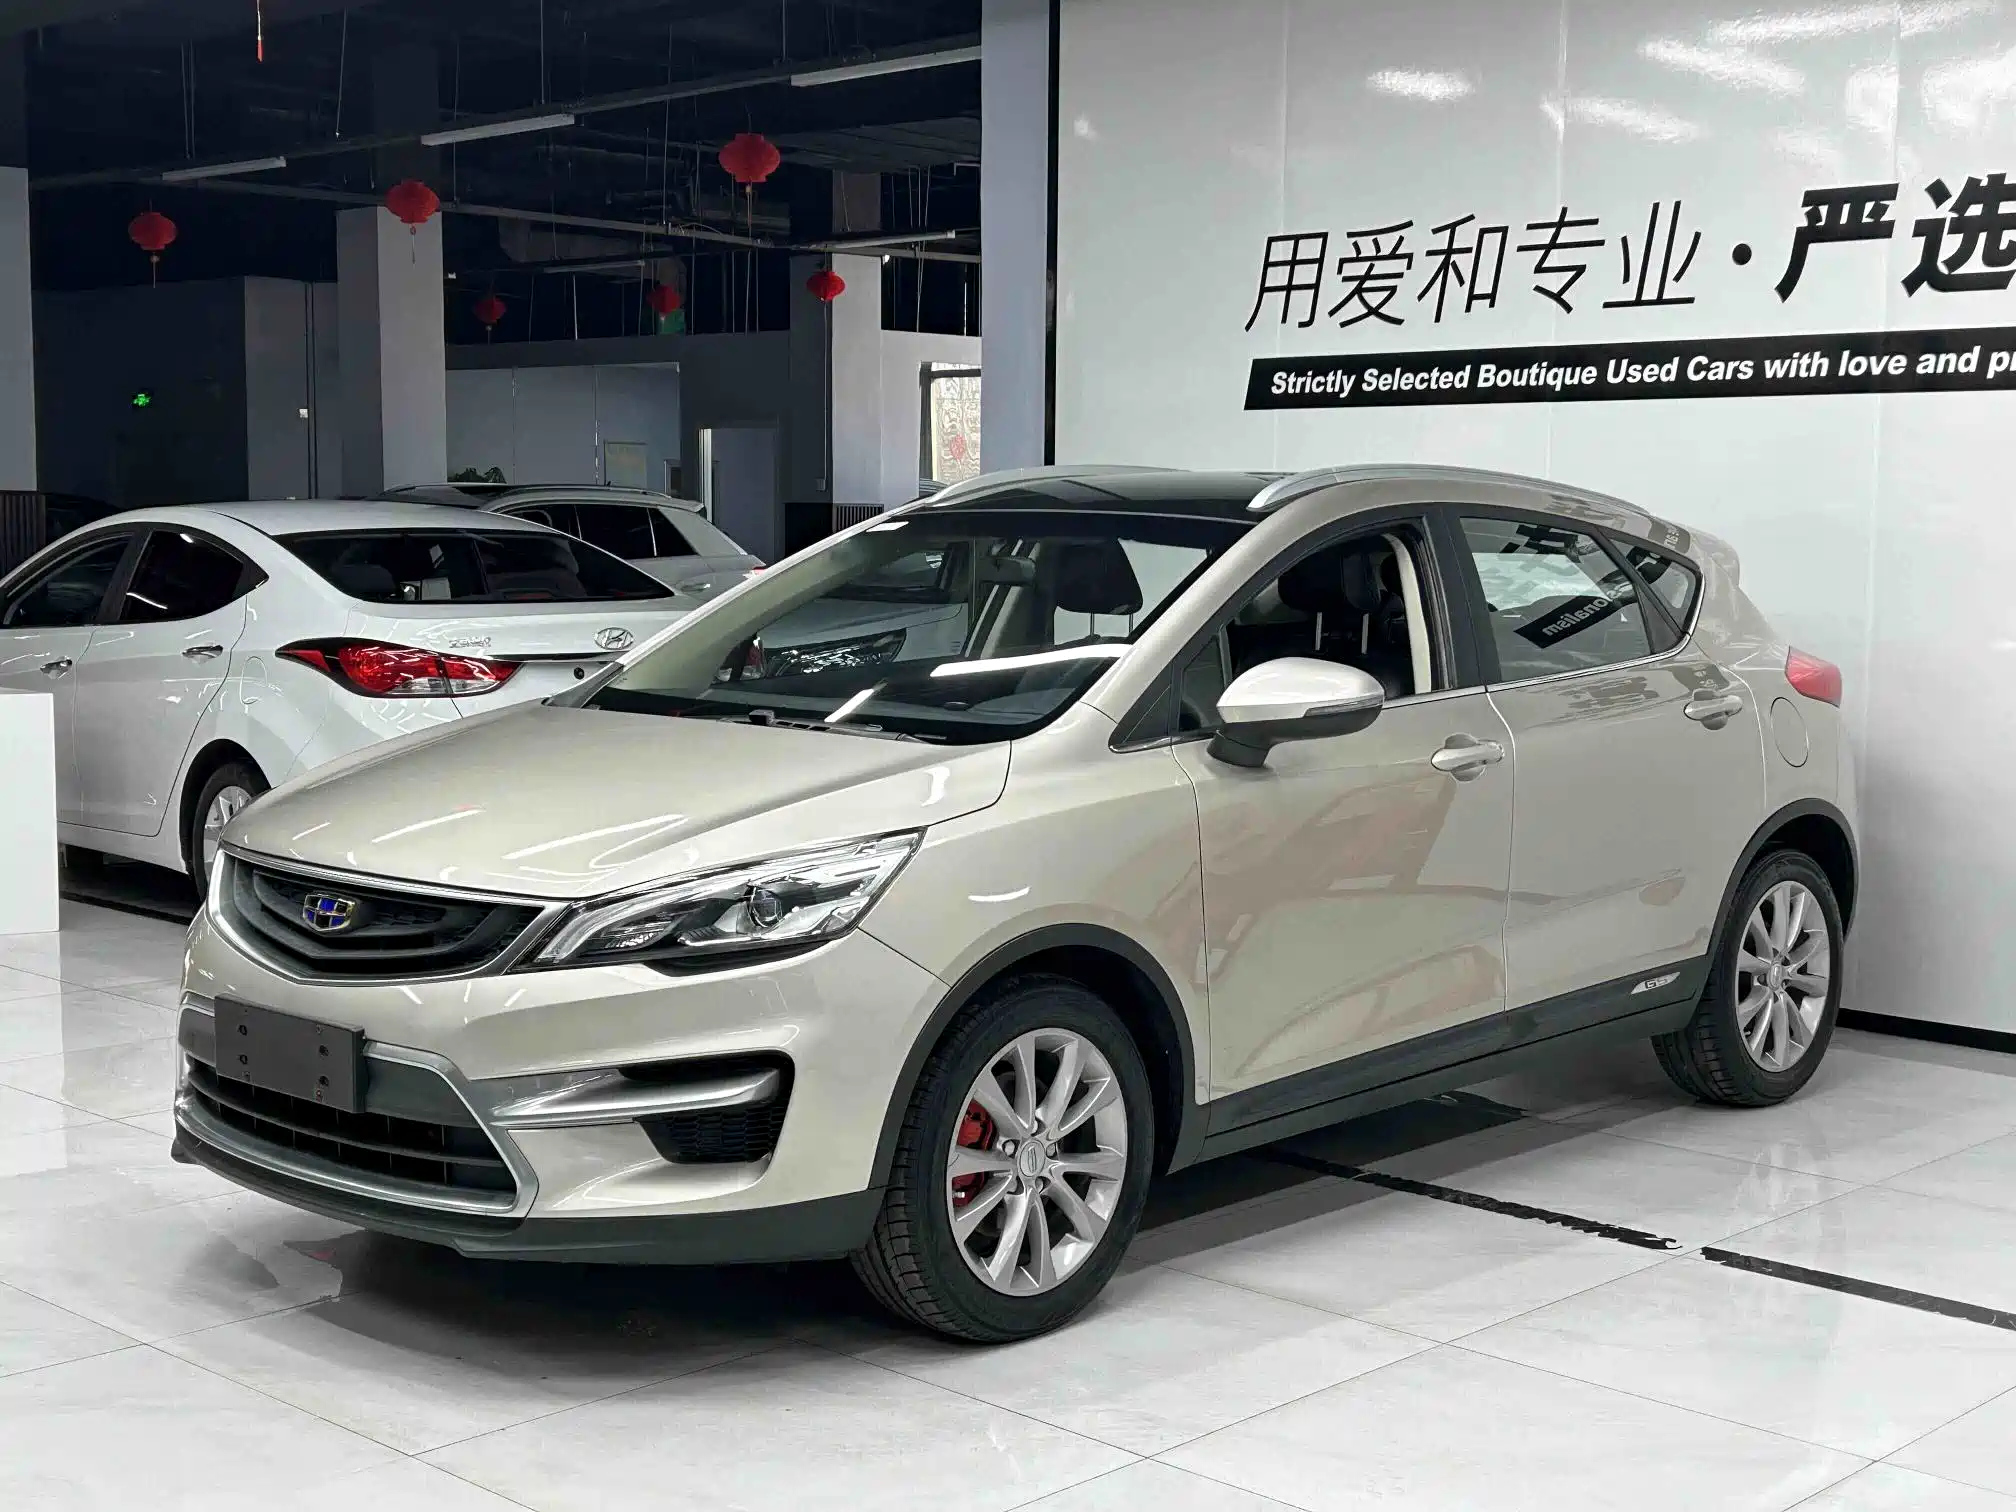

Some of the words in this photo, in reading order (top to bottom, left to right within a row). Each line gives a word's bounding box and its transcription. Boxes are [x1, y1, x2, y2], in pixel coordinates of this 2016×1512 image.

[1271, 368, 1356, 398] Strictly
[1361, 365, 1470, 391] Selected
[1477, 360, 1598, 391] Boutique
[1606, 357, 1680, 384] Used
[1687, 356, 1754, 381] Cars
[1764, 350, 1830, 379] with
[1839, 349, 1908, 376] love
[1916, 345, 1982, 374] and
